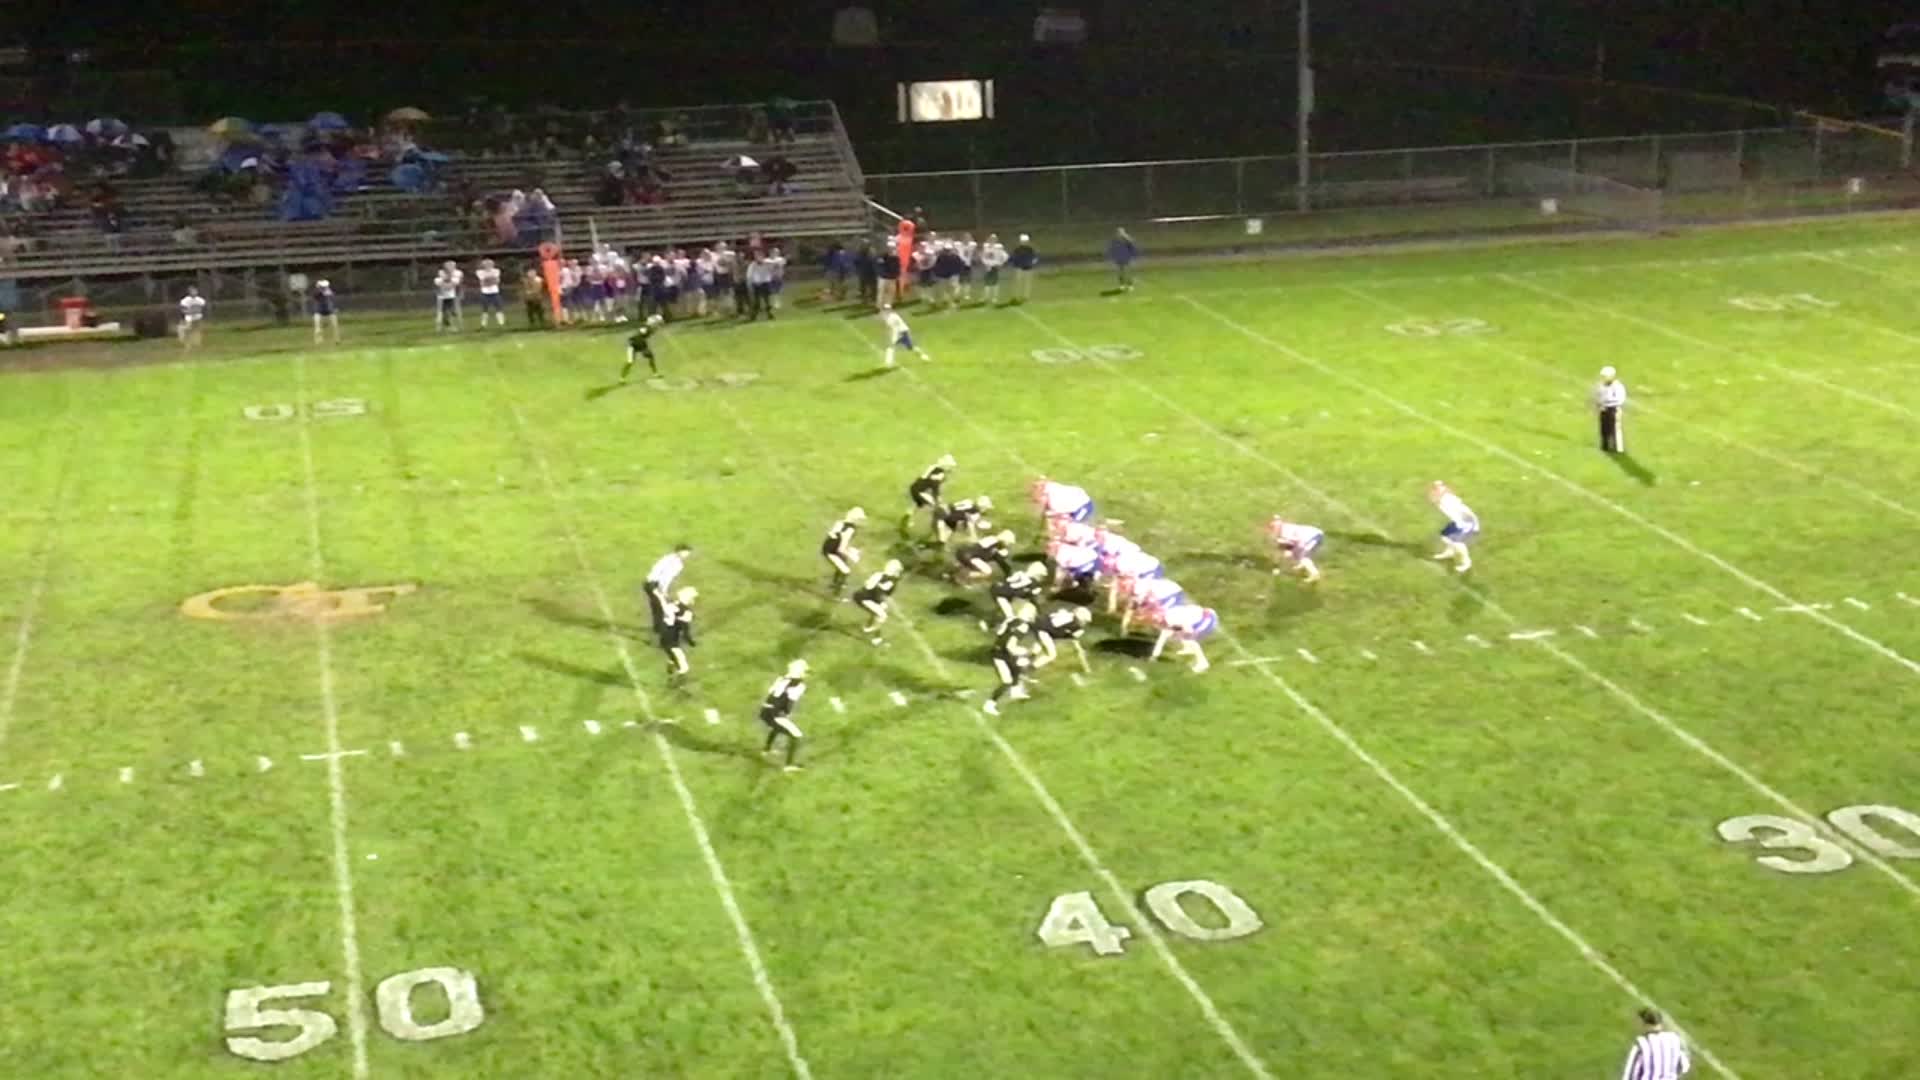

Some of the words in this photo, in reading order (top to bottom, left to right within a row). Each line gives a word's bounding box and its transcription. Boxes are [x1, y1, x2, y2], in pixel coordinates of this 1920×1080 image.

[1717, 804, 1920, 873] 30
[1037, 879, 1264, 956] 40
[224, 966, 485, 1061] 50
